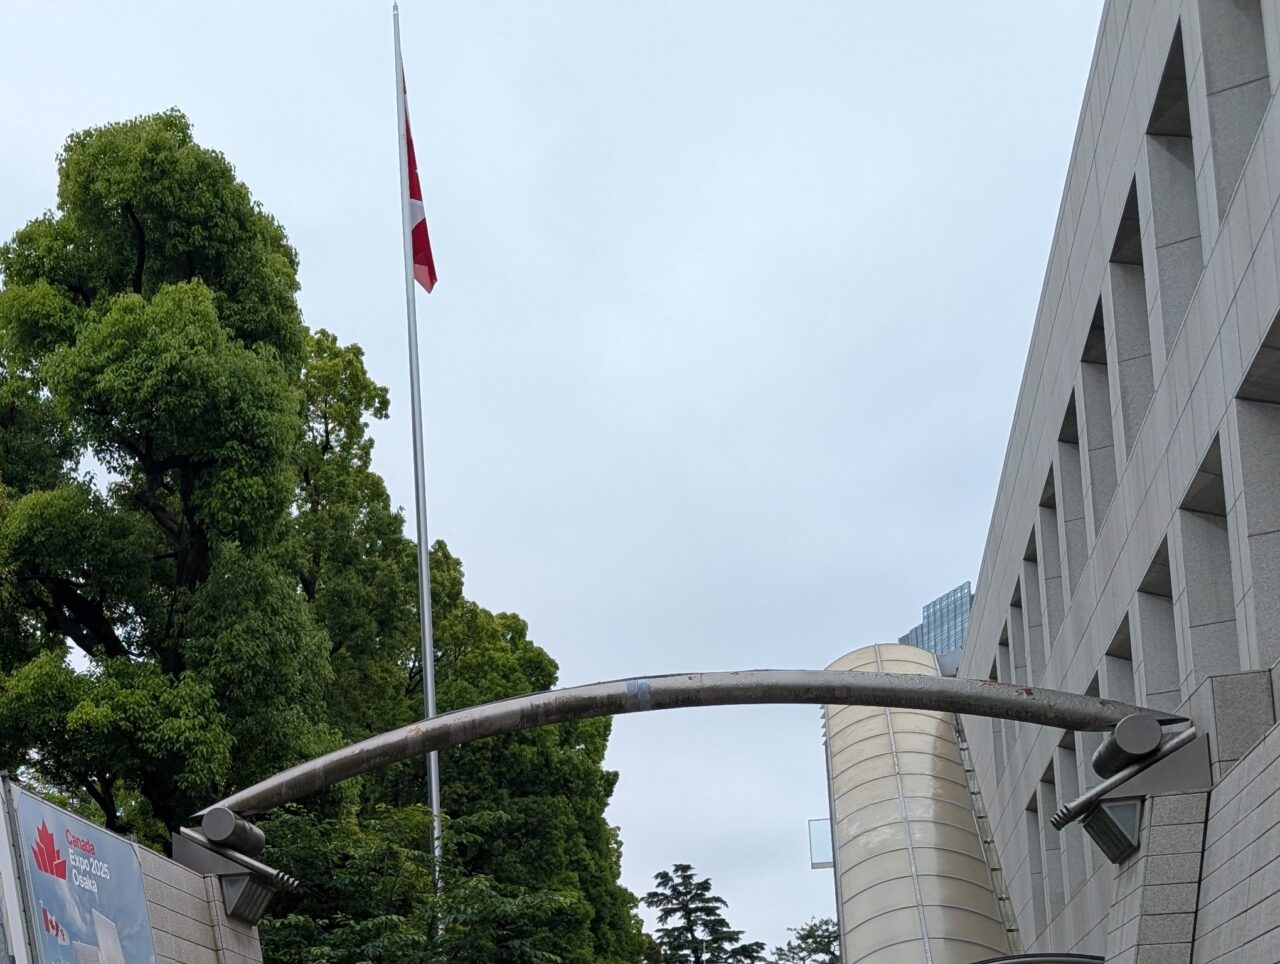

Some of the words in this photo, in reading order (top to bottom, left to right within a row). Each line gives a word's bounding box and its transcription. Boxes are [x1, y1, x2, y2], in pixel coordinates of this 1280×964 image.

[65, 828, 96, 856] Canada
[68, 848, 90, 873] Expo
[90, 857, 110, 880] 2025
[72, 868, 98, 893] Osaka
